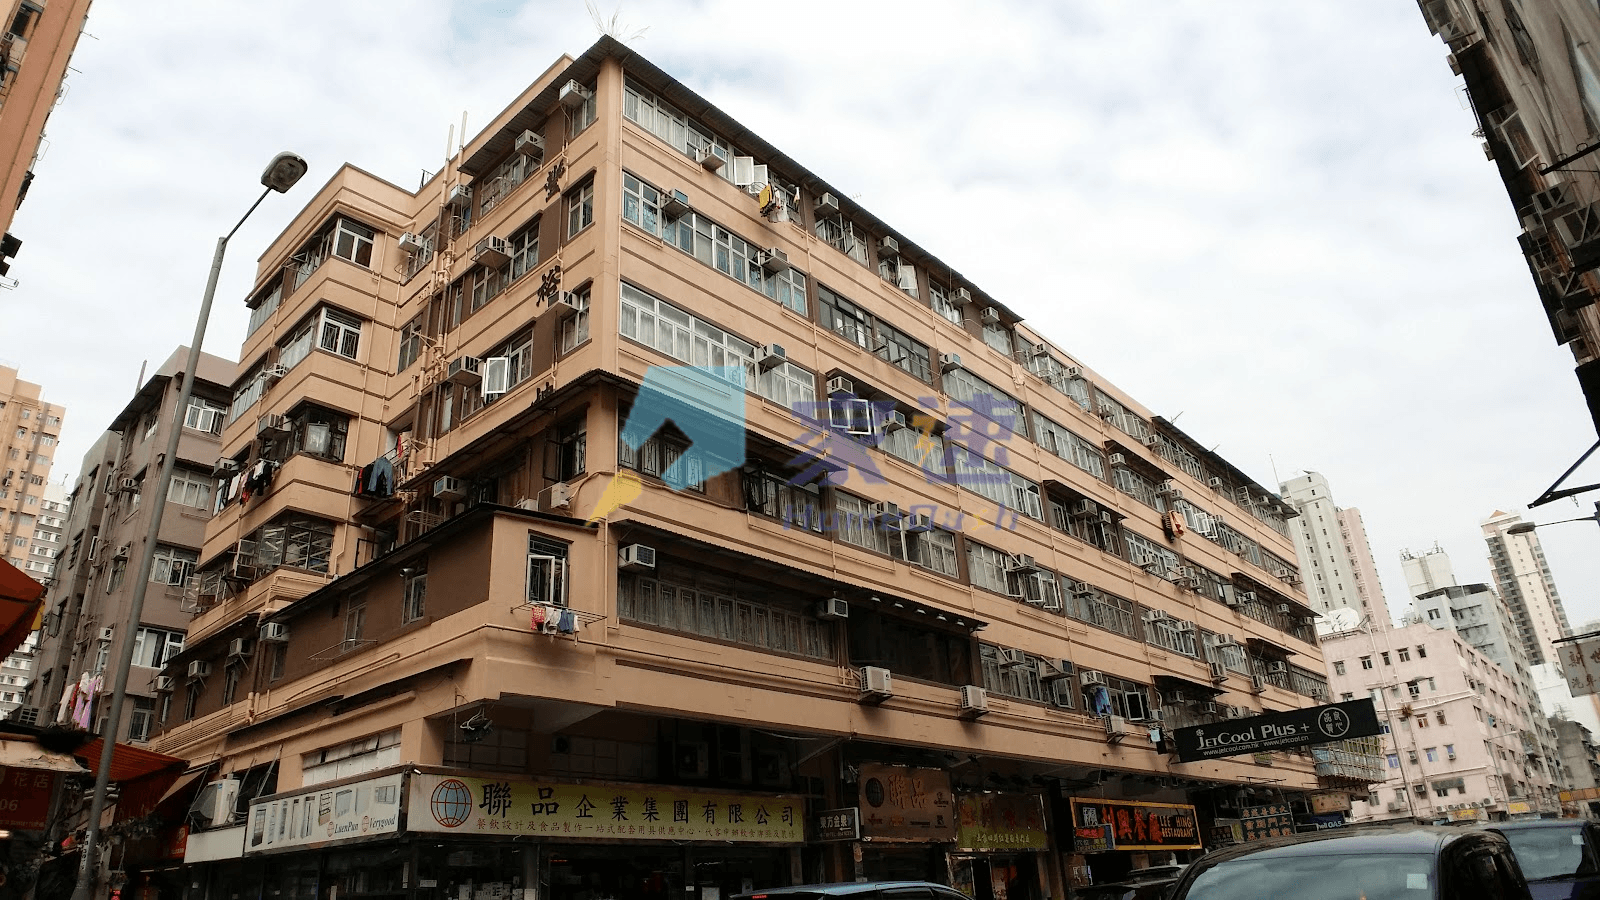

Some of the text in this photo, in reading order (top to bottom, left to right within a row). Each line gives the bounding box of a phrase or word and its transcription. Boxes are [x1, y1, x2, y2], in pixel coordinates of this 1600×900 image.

[1261, 723, 1296, 739] Plus
[479, 781, 795, 826] 聯品企業集團有限公司
[1160, 815, 1192, 828] LEE HING
[1161, 828, 1194, 838] RESTAURANT
